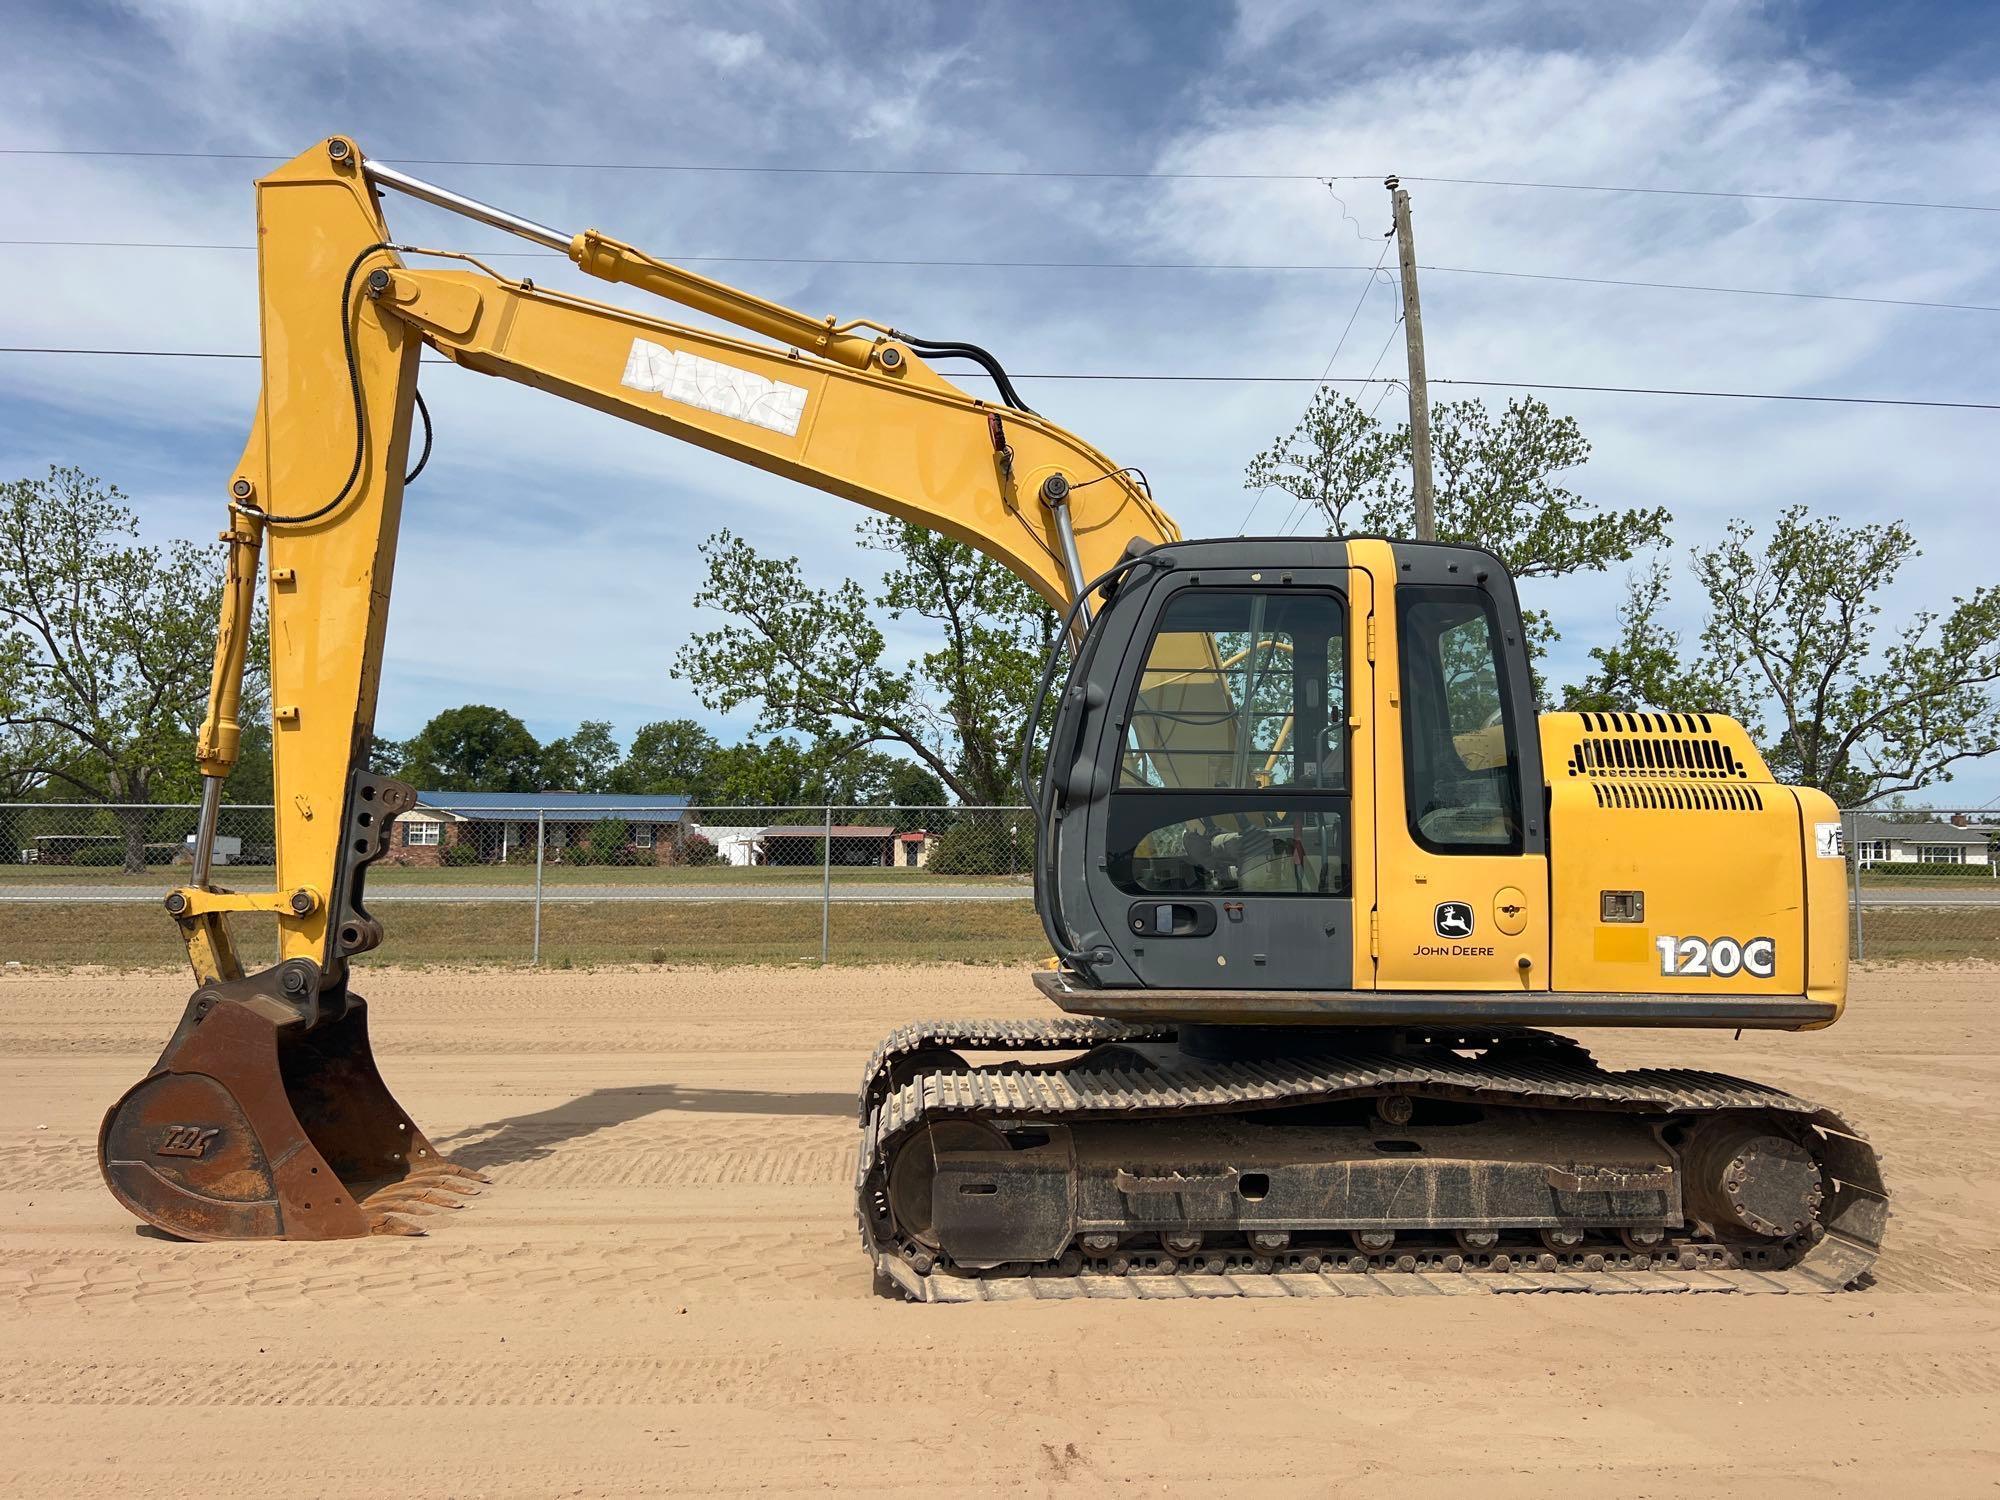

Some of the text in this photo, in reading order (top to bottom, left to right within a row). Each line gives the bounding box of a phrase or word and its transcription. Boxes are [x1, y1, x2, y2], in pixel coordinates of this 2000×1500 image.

[1413, 945, 1494, 956] JOHN DEERE
[1656, 935, 1776, 979] 120C
